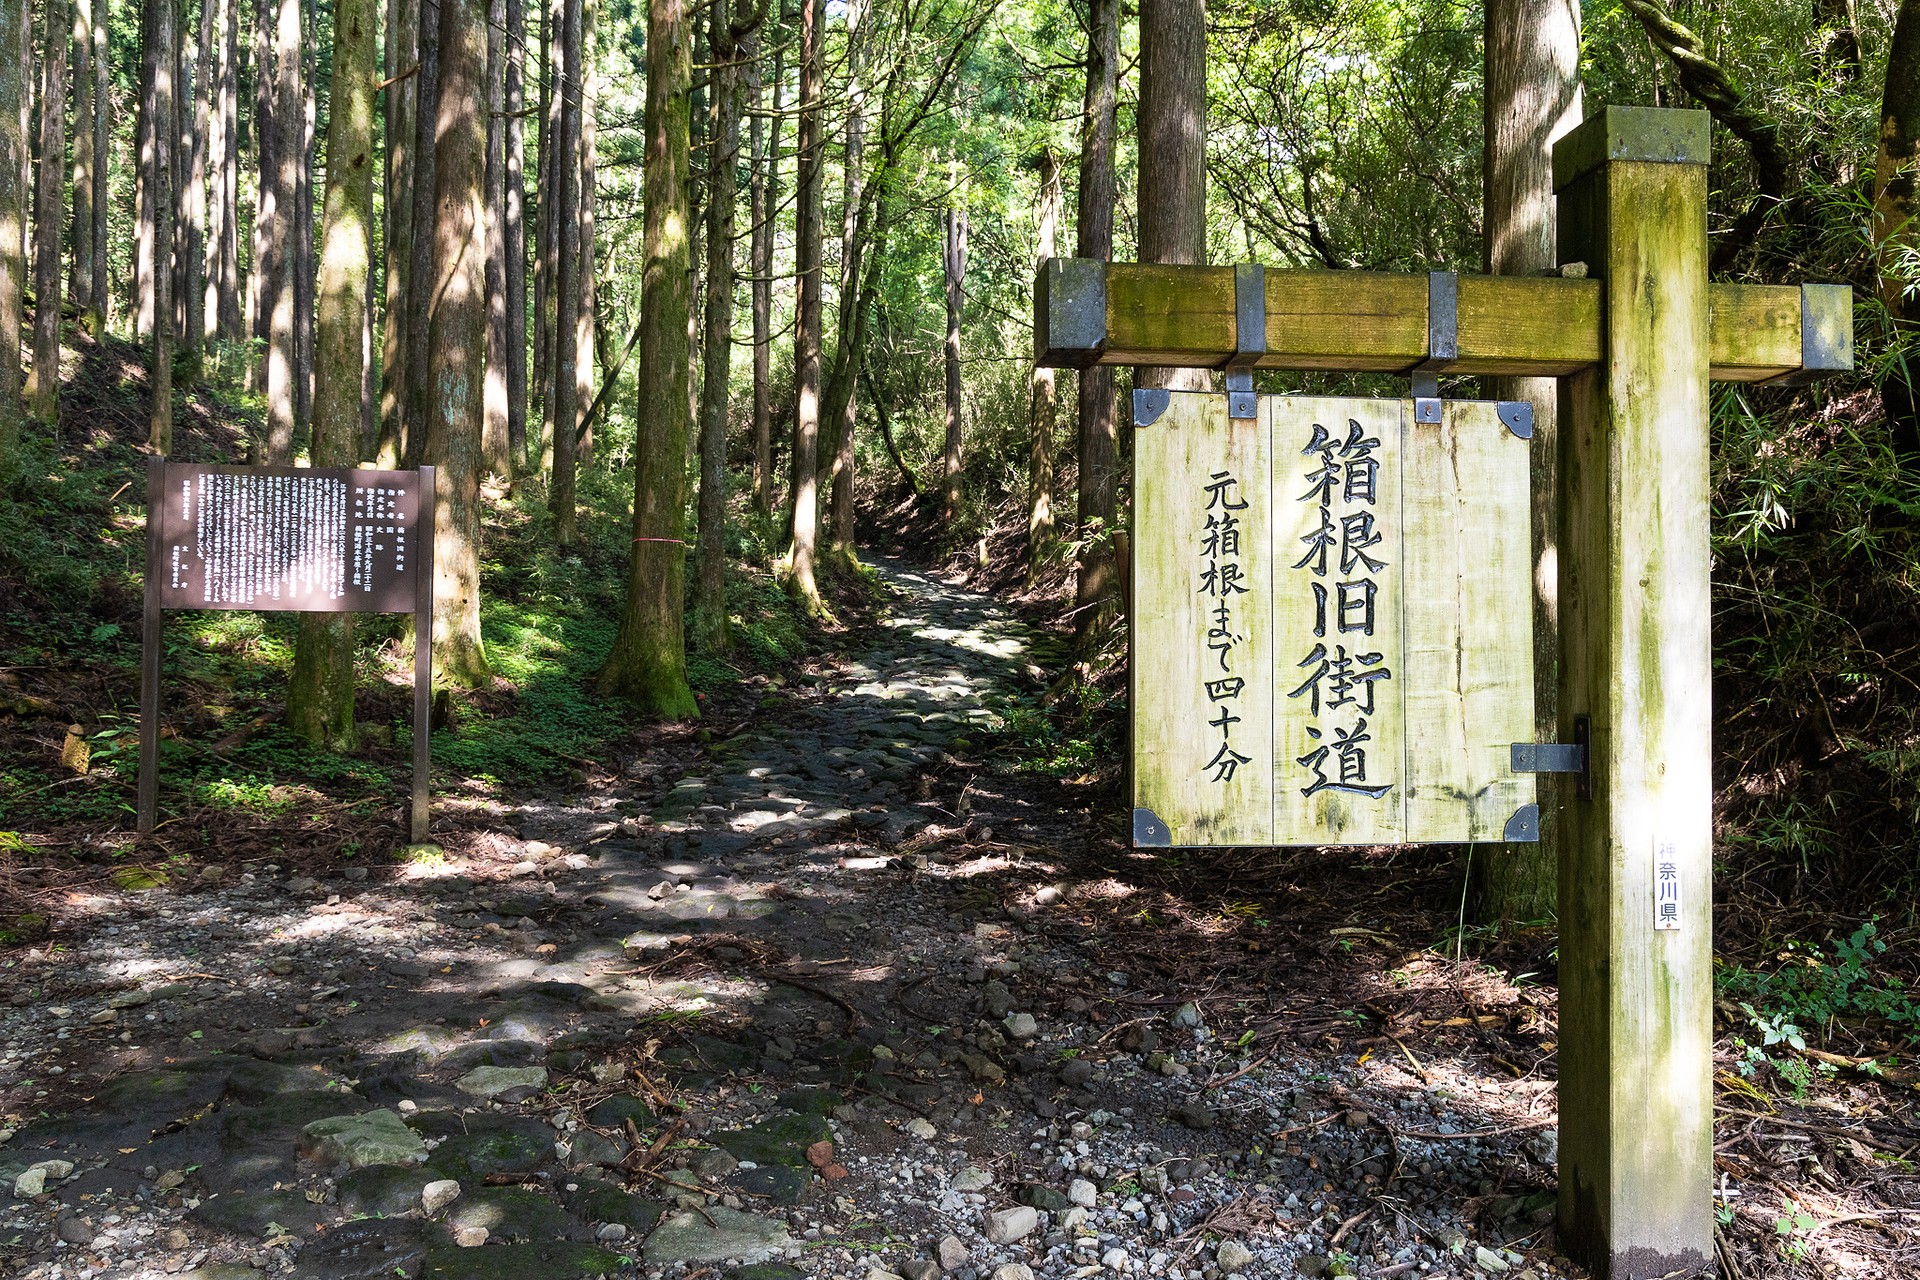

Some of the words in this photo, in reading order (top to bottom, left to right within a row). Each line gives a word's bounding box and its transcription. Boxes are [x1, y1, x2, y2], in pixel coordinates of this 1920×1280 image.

[1197, 470, 1252, 783] 元箱根まで四十分
[1287, 418, 1394, 799] 箱根旧街道
[1659, 843, 1678, 922] 神奈川県
